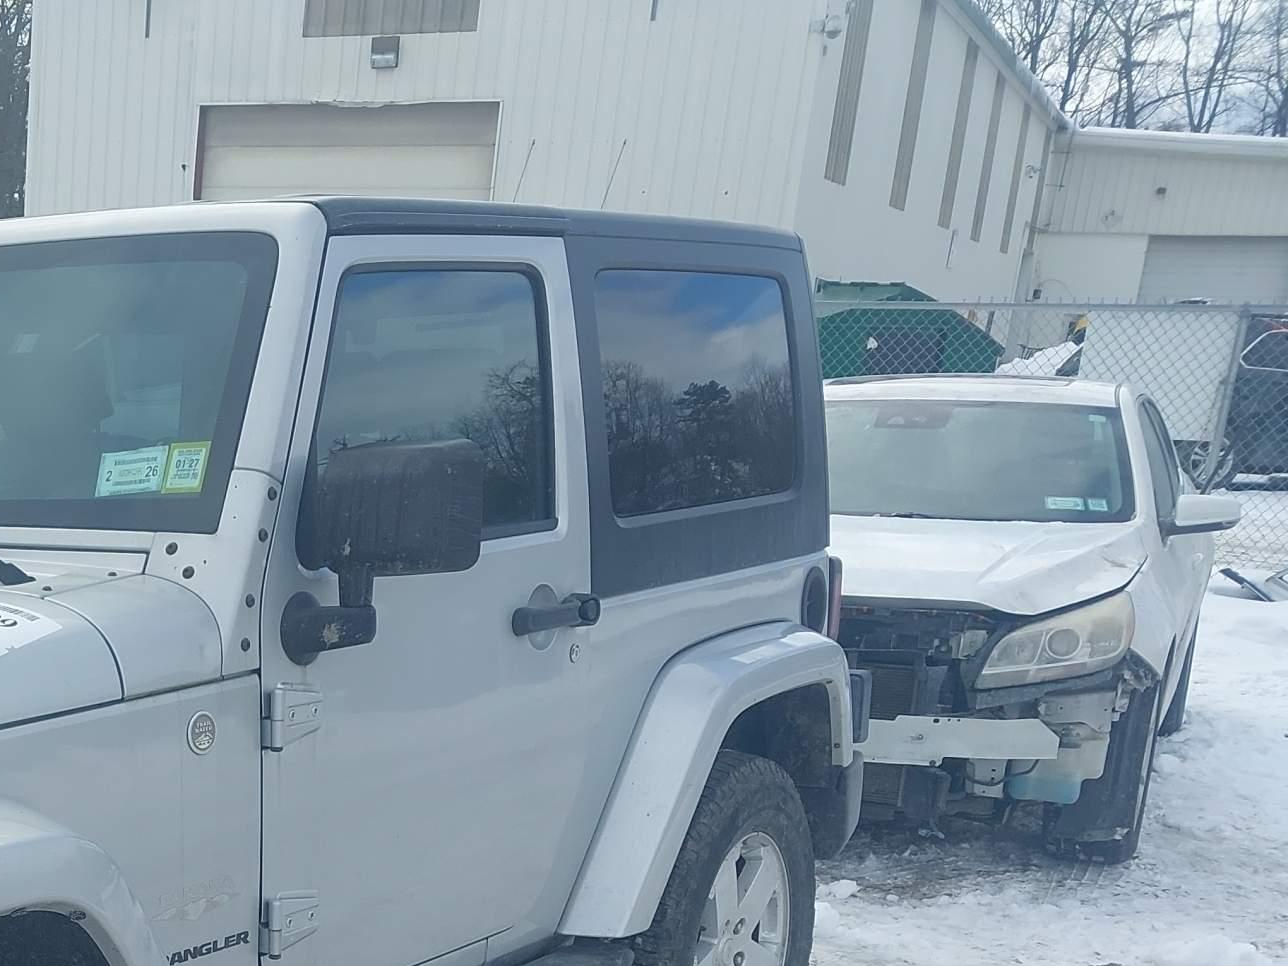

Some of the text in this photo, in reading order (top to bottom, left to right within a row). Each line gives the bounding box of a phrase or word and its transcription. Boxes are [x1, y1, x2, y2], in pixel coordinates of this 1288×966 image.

[105, 470, 113, 482] 2
[144, 465, 159, 478] 26
[166, 930, 250, 966] ANGLER
